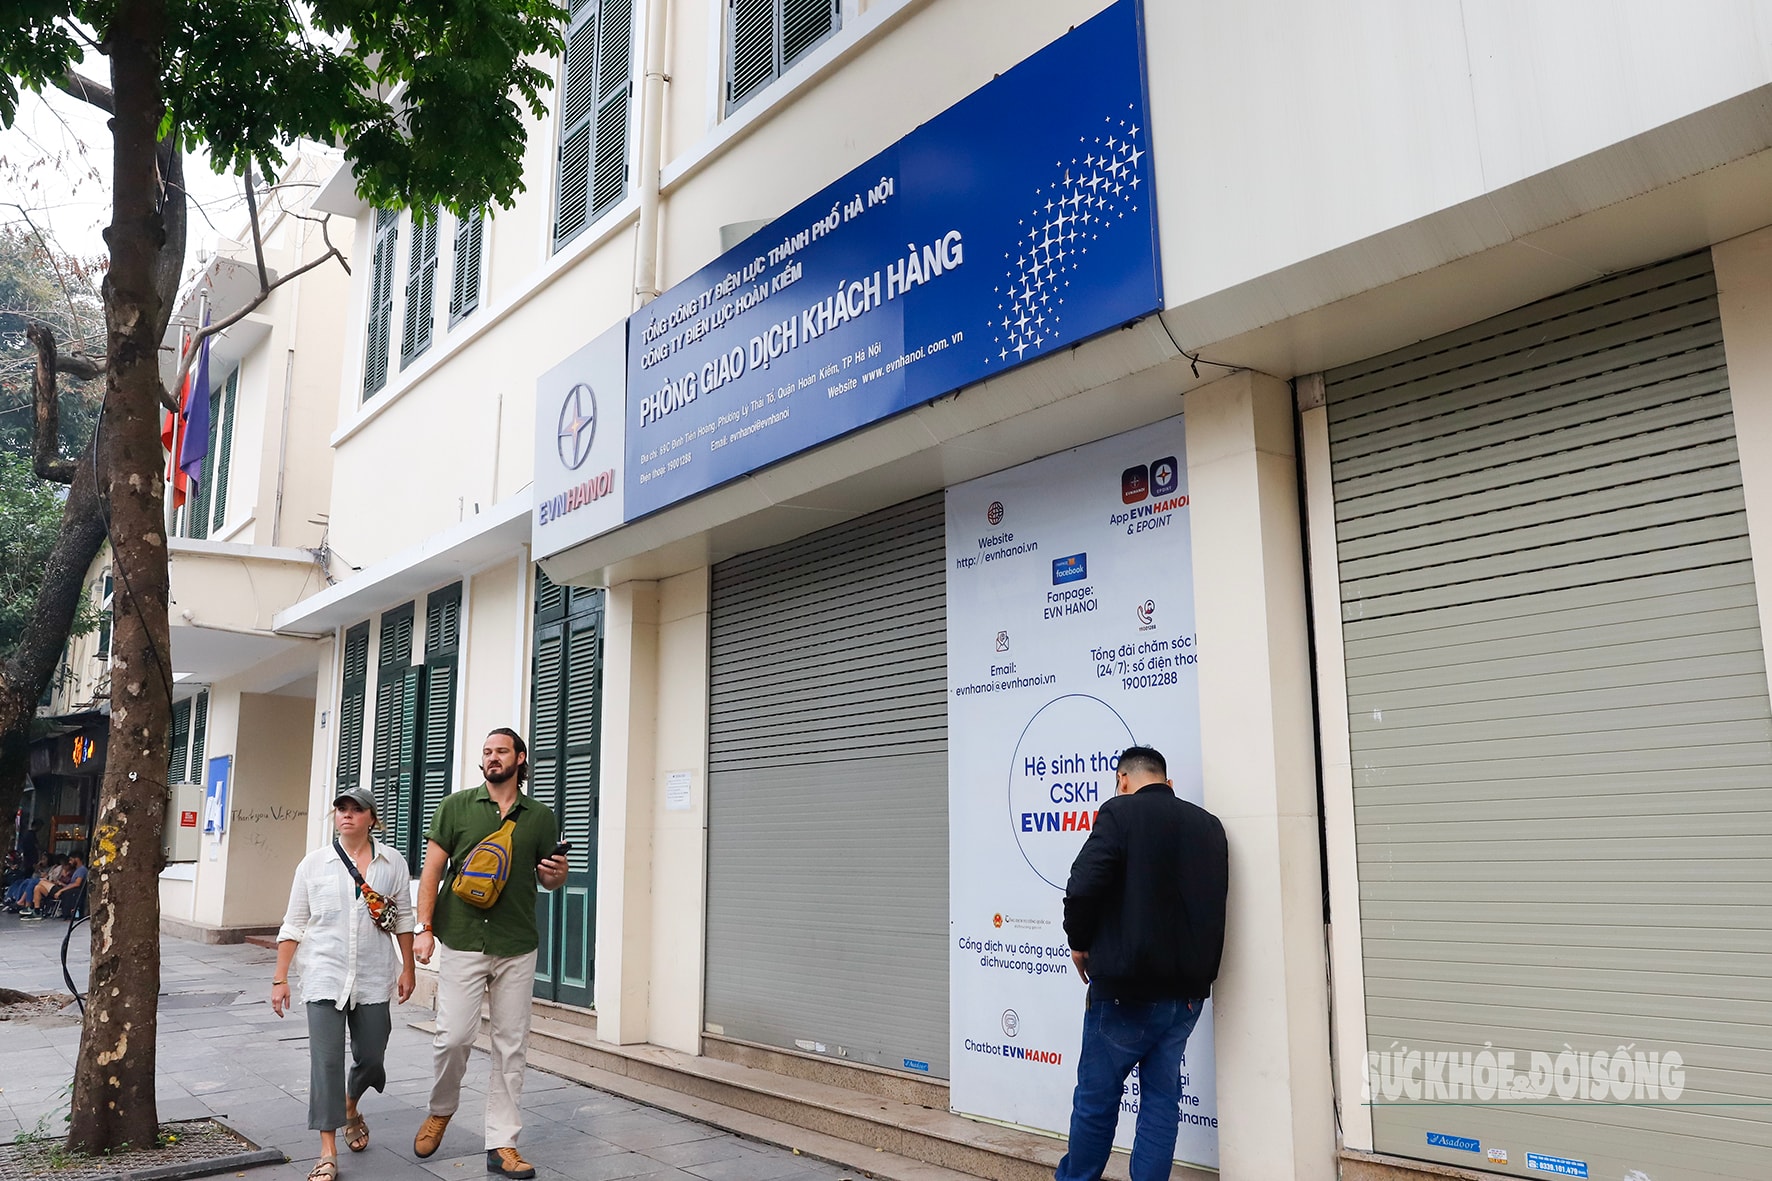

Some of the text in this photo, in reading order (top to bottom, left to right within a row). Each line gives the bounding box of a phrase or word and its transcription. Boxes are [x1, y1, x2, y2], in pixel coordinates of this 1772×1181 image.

[641, 177, 894, 345] TỔNG CÔNG TY ĐIỆN LỰC THÀNH PHỐ HÀ NỘI
[641, 260, 802, 369] CÔNG TY ĐIỆN LỰC HOÀN KIẾM
[640, 230, 963, 428] PHÒNG GIAO DỊCH KHÁCH HÀNG
[778, 383, 796, 399] Quận
[798, 373, 817, 389] Hoàn
[819, 362, 840, 380] Kiếm,
[842, 356, 853, 370] TP
[855, 351, 866, 364] Hà
[868, 342, 882, 357] Nội
[710, 436, 728, 451] Email:
[827, 377, 858, 399] Website
[862, 366, 885, 384] www.
[951, 331, 963, 344] vn
[540, 468, 615, 525] EVNHANOI
[1109, 495, 1190, 525] App EVNHANOI
[1127, 514, 1172, 535] & EPOINT
[978, 533, 1014, 549] Website
[956, 541, 1038, 568] http://evnhanoi.vn
[1056, 564, 1084, 577] facebook
[1047, 586, 1093, 603] Fanpage:
[1044, 598, 1098, 619] EVN HANOI
[1090, 647, 1116, 662] Tổng
[1118, 644, 1135, 657] đài
[1138, 640, 1168, 654] chăm
[1171, 635, 1191, 649] sóc
[990, 662, 1016, 676] Email:
[1096, 660, 1130, 678] (24/7):
[1132, 657, 1145, 672] số
[1147, 656, 1172, 672] điện
[956, 674, 1056, 696] evnhanoi@evnhanoi.vn
[1122, 671, 1178, 690] 190012288
[1025, 750, 1126, 781] Hệ sinh thá
[1050, 781, 1098, 804] CSKH
[958, 936, 1071, 959] Cổng dịch vụ công quốc
[980, 956, 1067, 975] dichvucong.gov.vn
[964, 1039, 1062, 1065] Chatbot EVNHANOI
[1438, 1136, 1477, 1150] Asadoor
